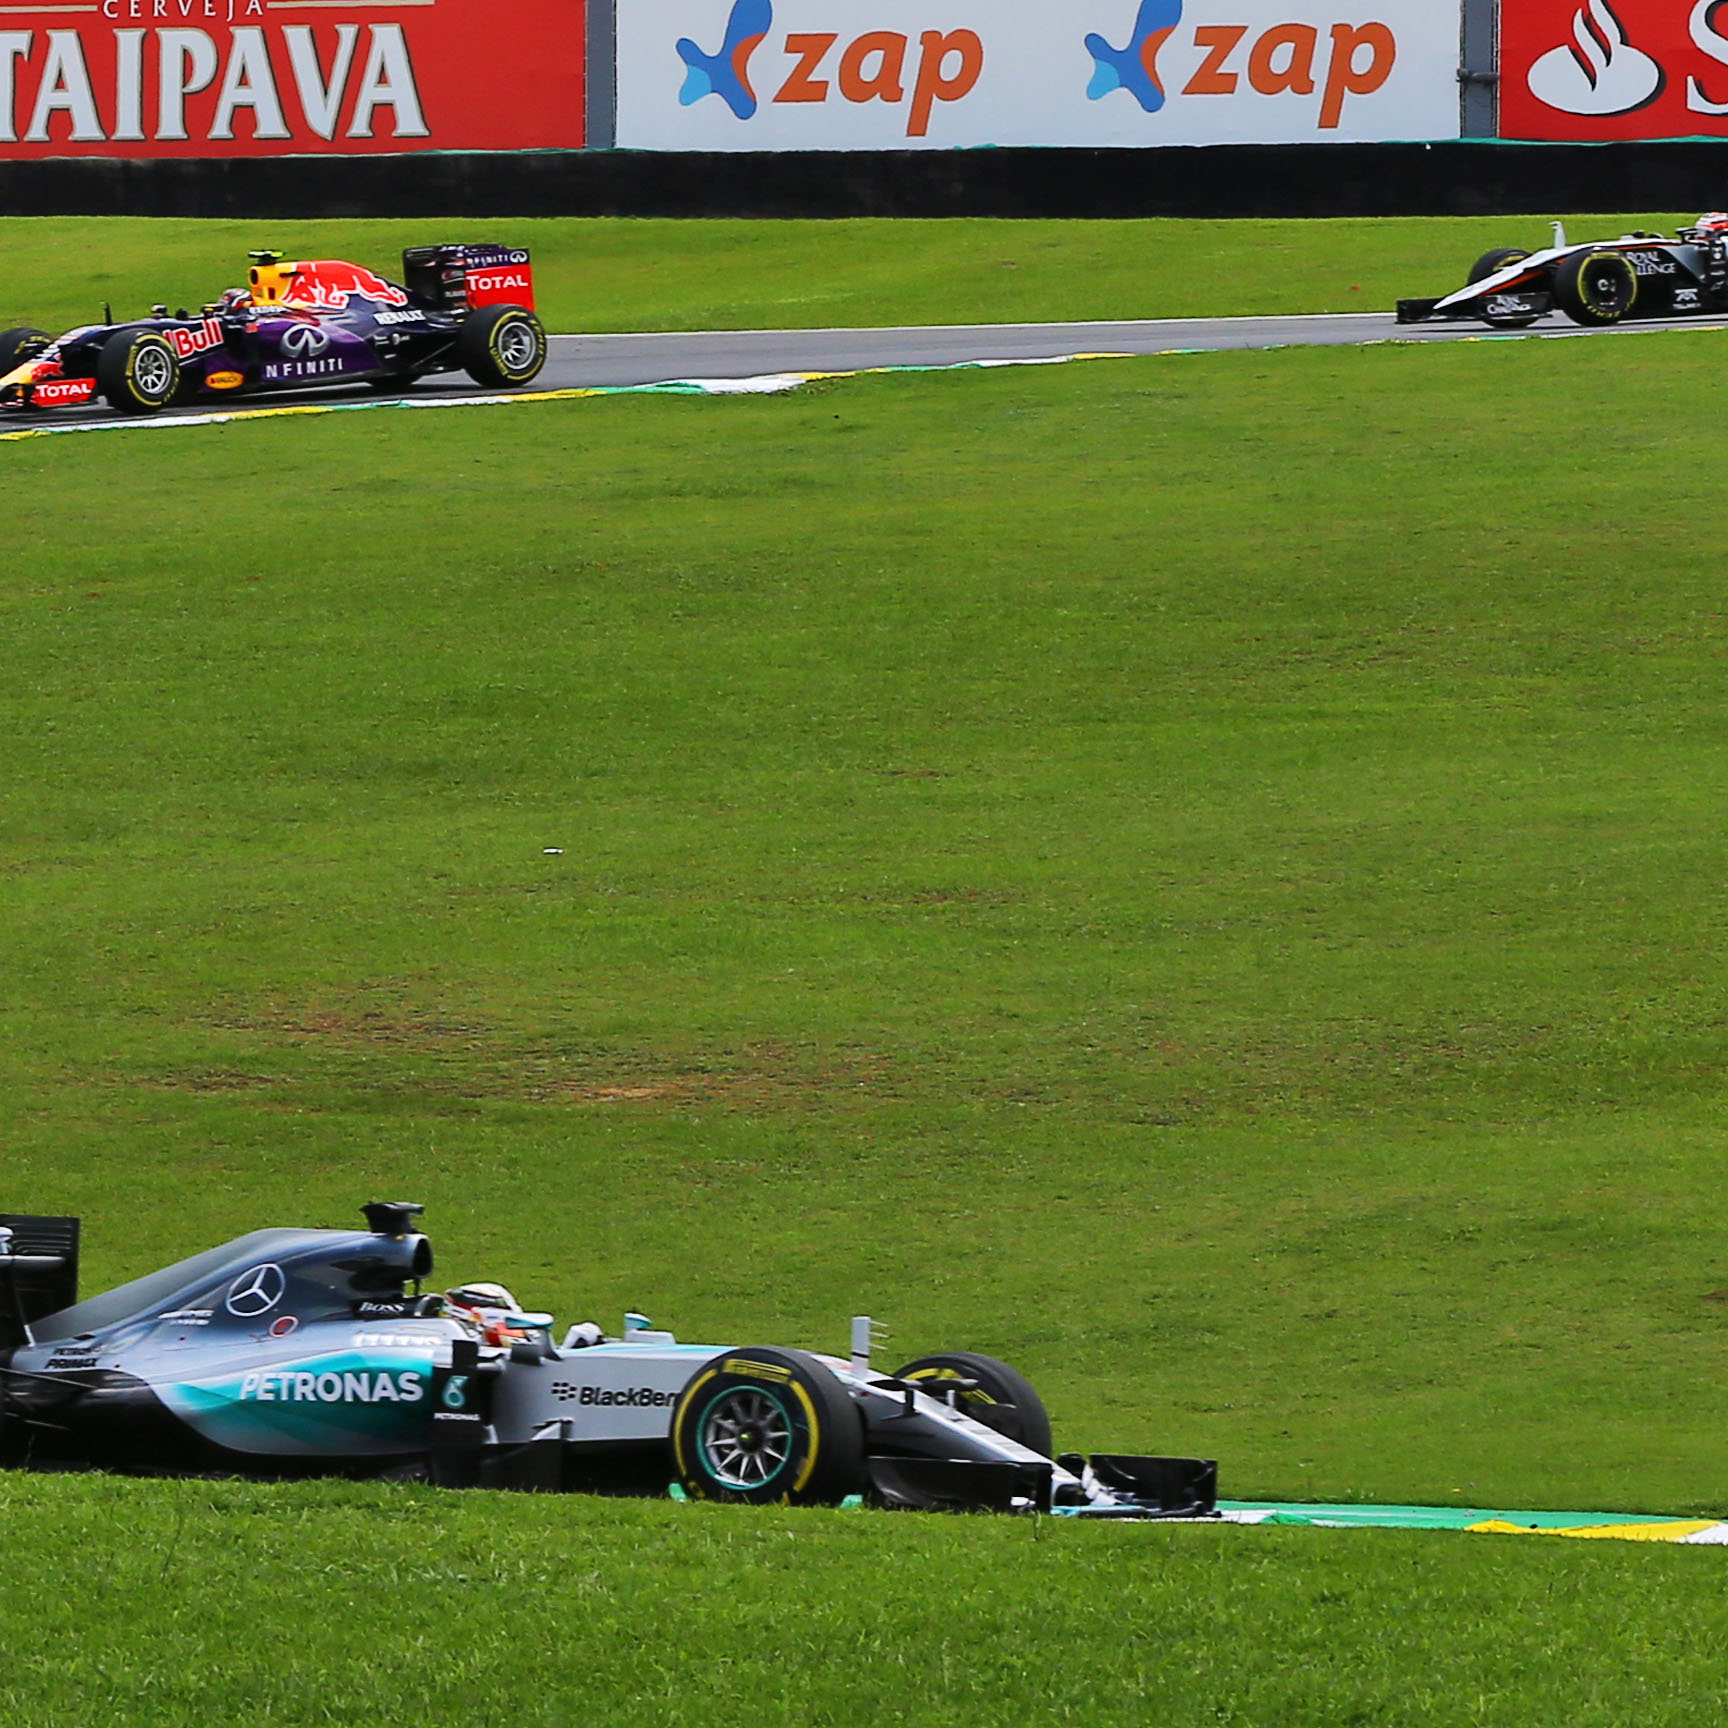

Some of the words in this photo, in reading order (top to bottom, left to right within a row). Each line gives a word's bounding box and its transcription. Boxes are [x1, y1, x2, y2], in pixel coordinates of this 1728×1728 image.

[772, 27, 984, 138] zap
[1181, 20, 1397, 129] zap
[465, 274, 529, 291] TOTAL
[373, 309, 427, 326] RENAULT
[175, 317, 225, 360] Bull
[35, 382, 92, 398] TOTAL
[239, 1371, 424, 1403] PETRONAS
